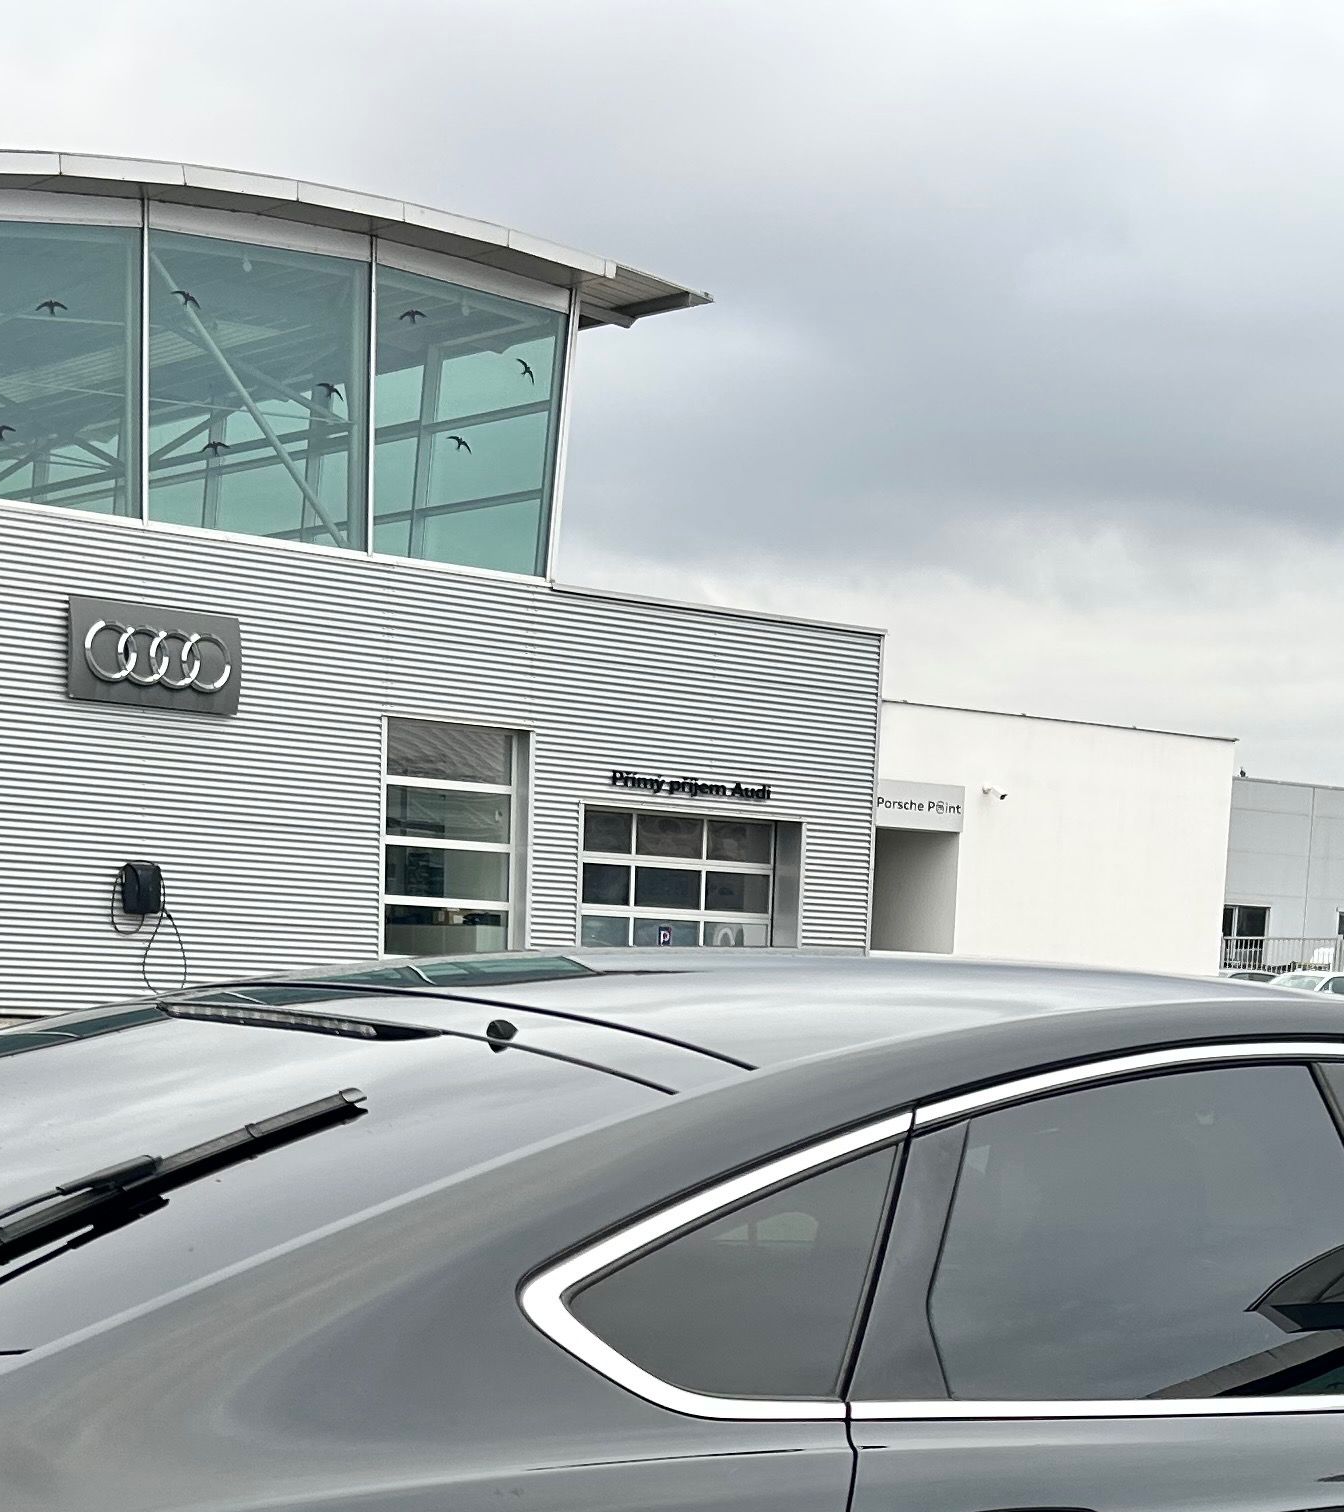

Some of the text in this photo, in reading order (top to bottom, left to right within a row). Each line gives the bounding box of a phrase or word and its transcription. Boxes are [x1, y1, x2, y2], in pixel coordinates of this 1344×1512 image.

[612, 769, 772, 800] Přímý příjem Audi
[876, 796, 924, 812] Porsche
